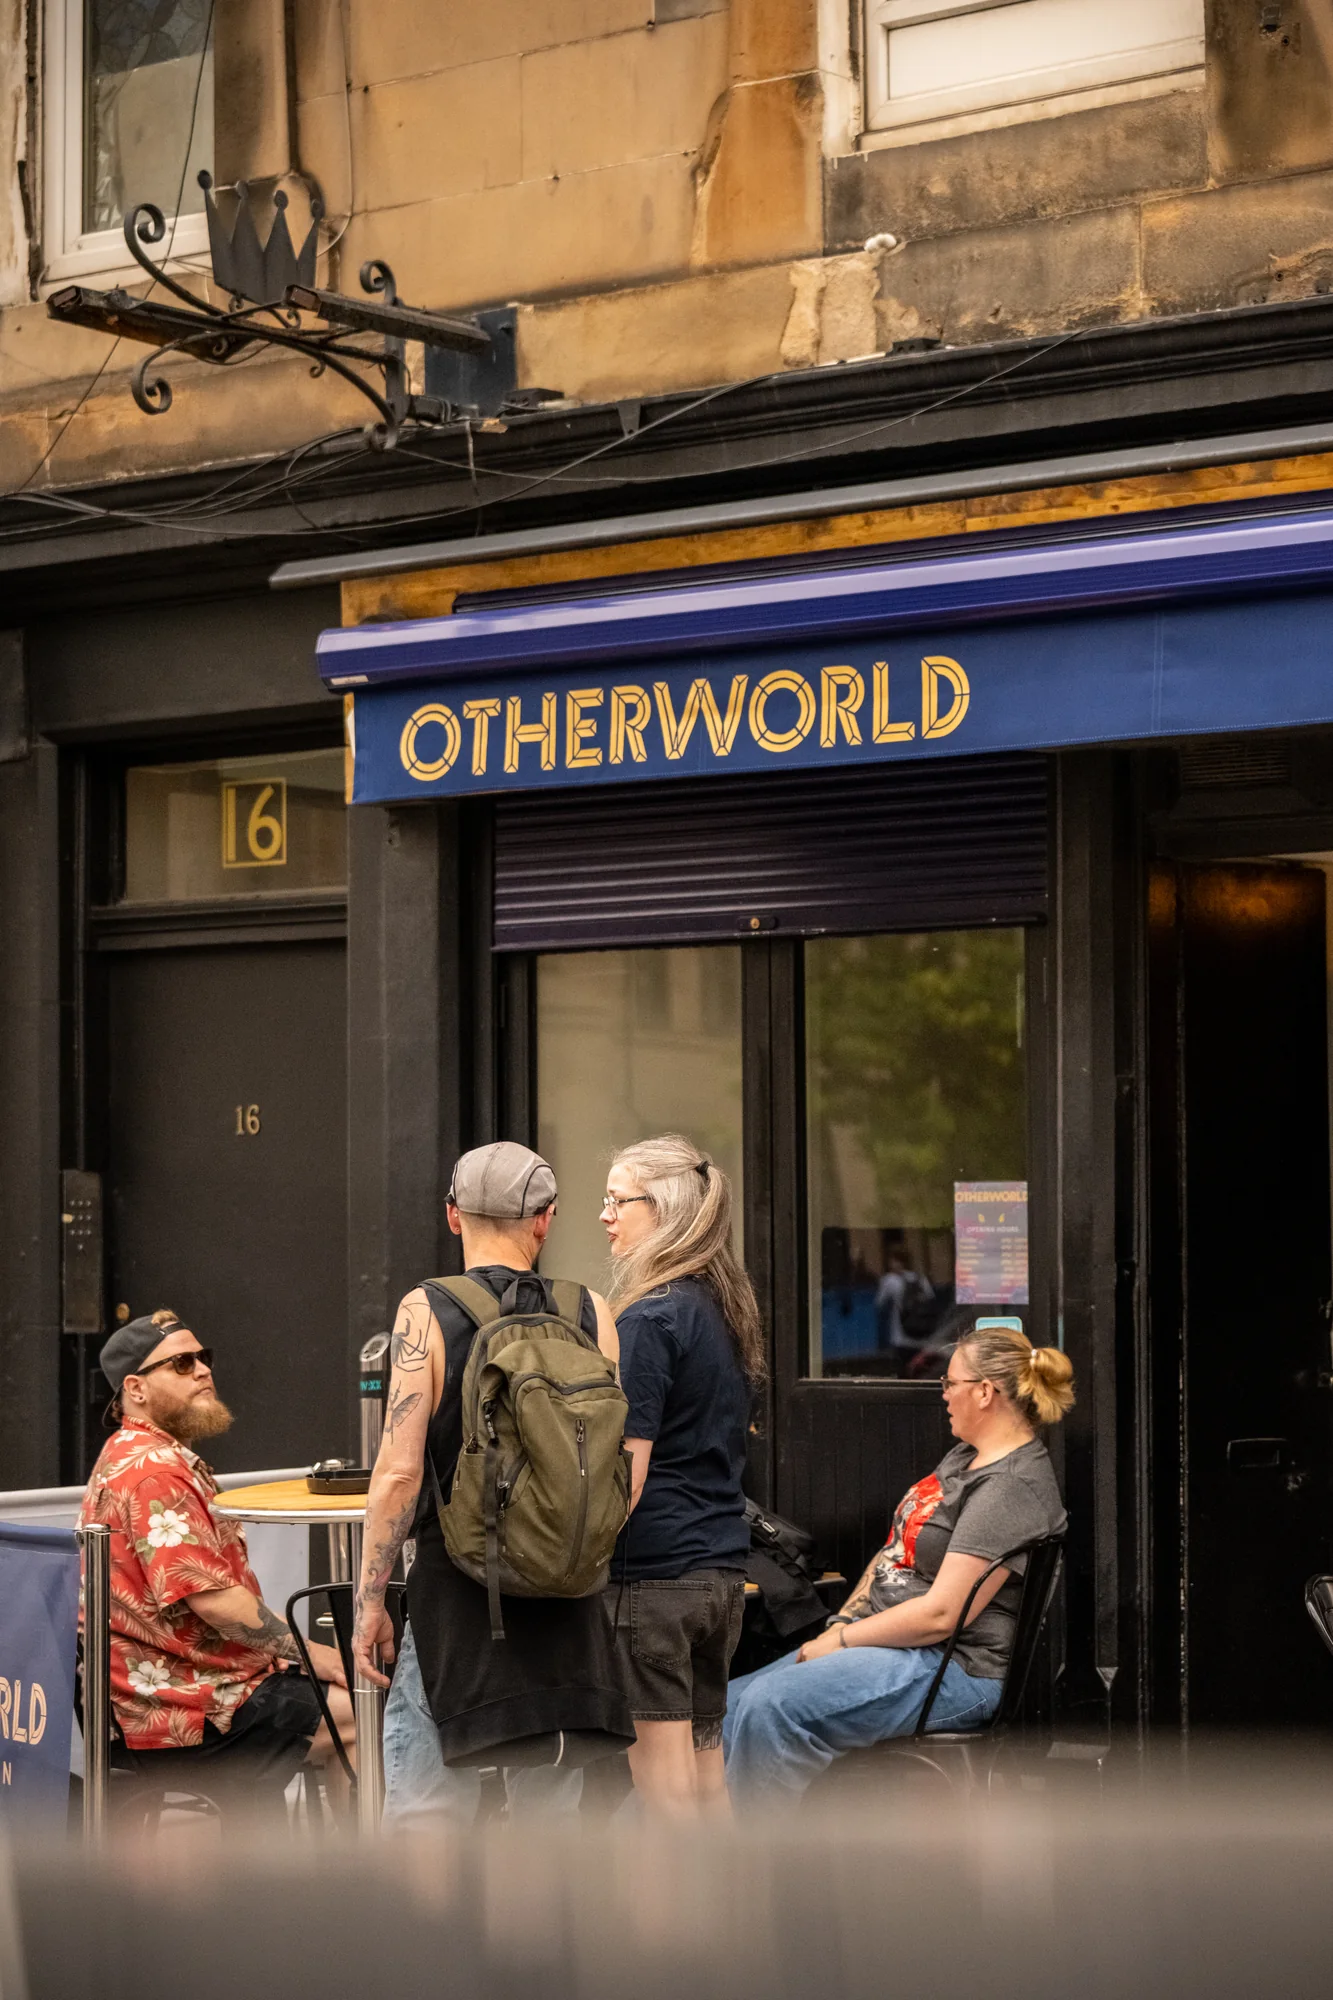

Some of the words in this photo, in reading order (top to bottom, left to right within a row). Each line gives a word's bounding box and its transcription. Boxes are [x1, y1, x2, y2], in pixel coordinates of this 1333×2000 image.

[400, 655, 971, 782] OTHERWORLD
[227, 784, 282, 861] 16
[235, 1104, 260, 1136] 16
